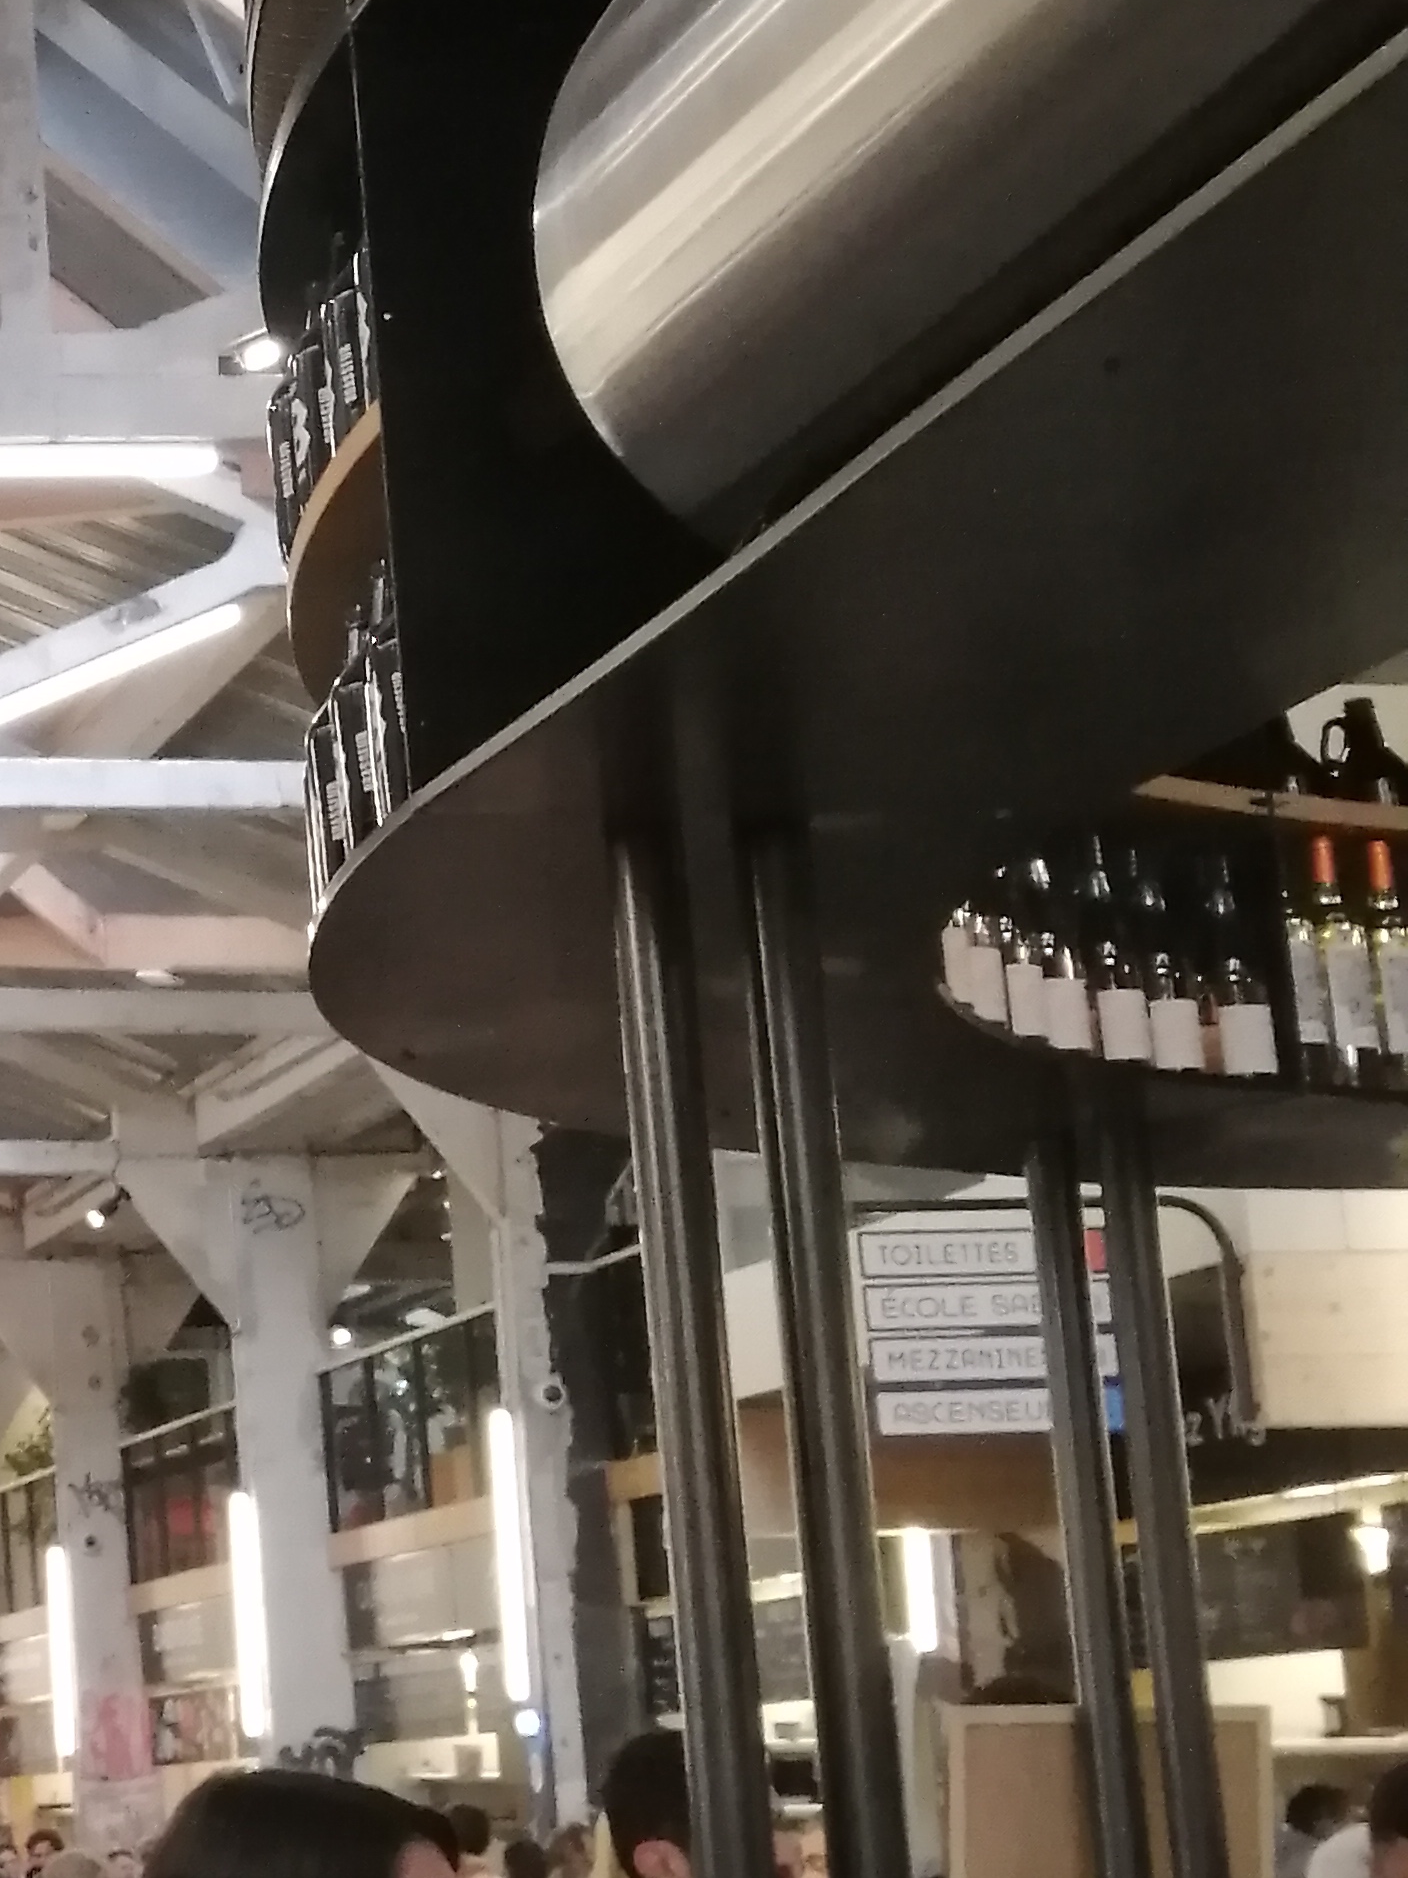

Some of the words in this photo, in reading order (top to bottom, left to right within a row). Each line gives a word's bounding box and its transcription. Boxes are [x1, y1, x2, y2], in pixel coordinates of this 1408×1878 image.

[878, 1242, 1018, 1267] TOILETTES
[881, 1291, 978, 1320] ÉCOLE
[887, 1347, 1046, 1372] MEZZANINE
